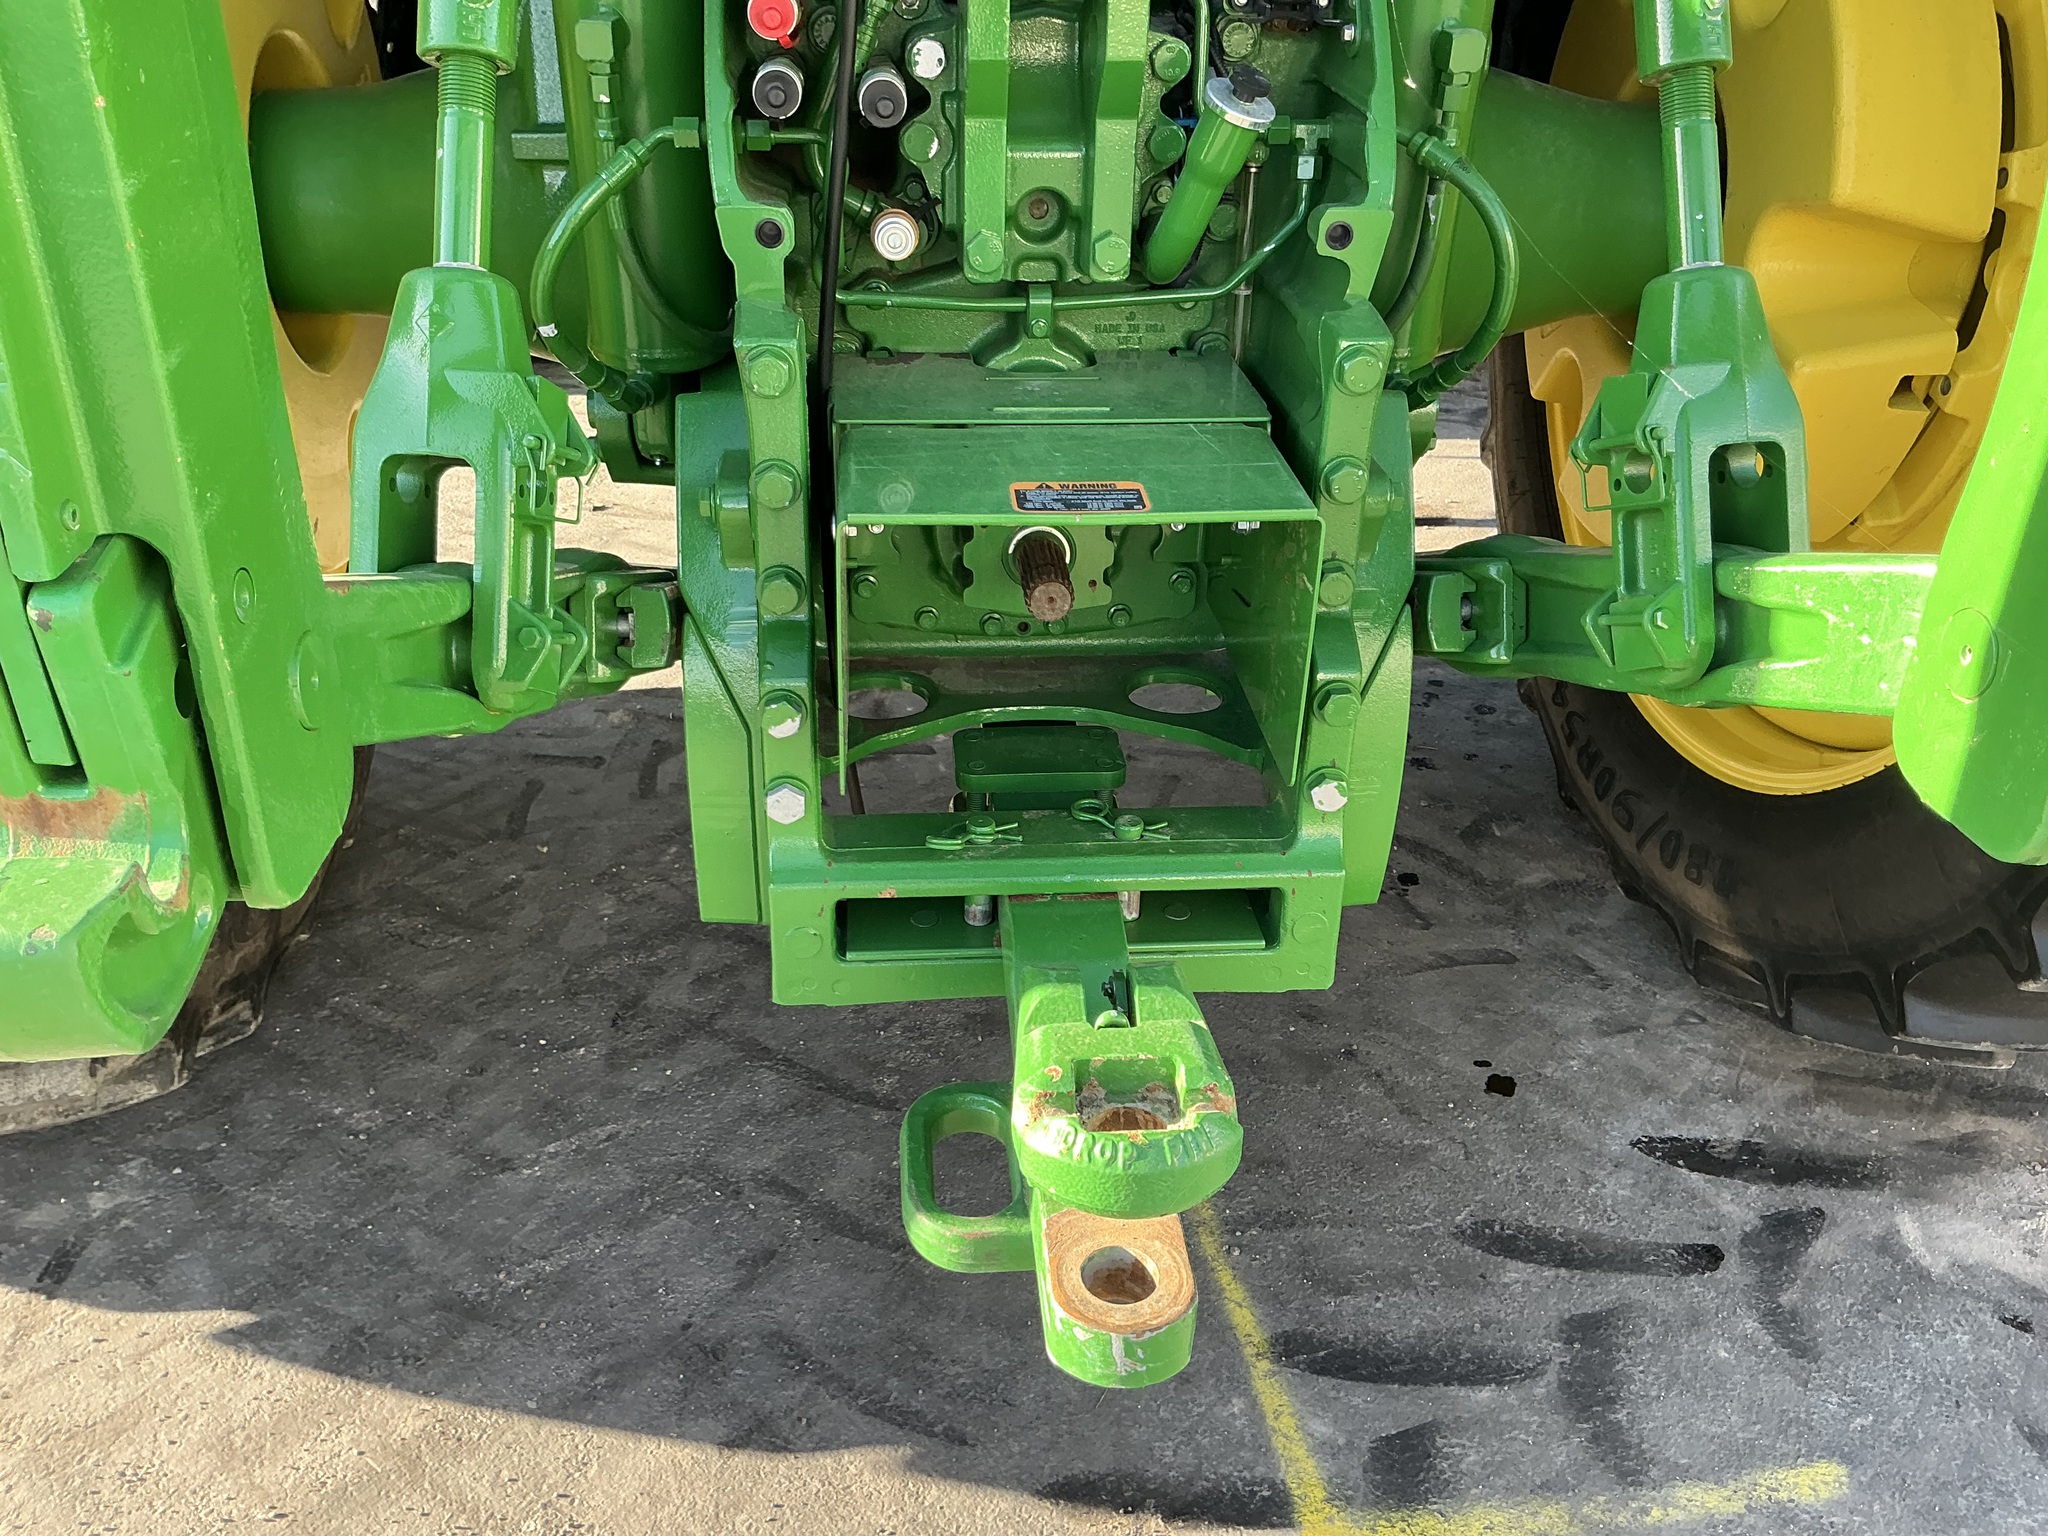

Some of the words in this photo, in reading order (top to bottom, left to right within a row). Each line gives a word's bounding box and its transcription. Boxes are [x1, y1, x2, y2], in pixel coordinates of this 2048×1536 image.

[1094, 323, 1122, 333] MADE
[1127, 323, 1140, 333] IN
[1145, 323, 1165, 333] USA
